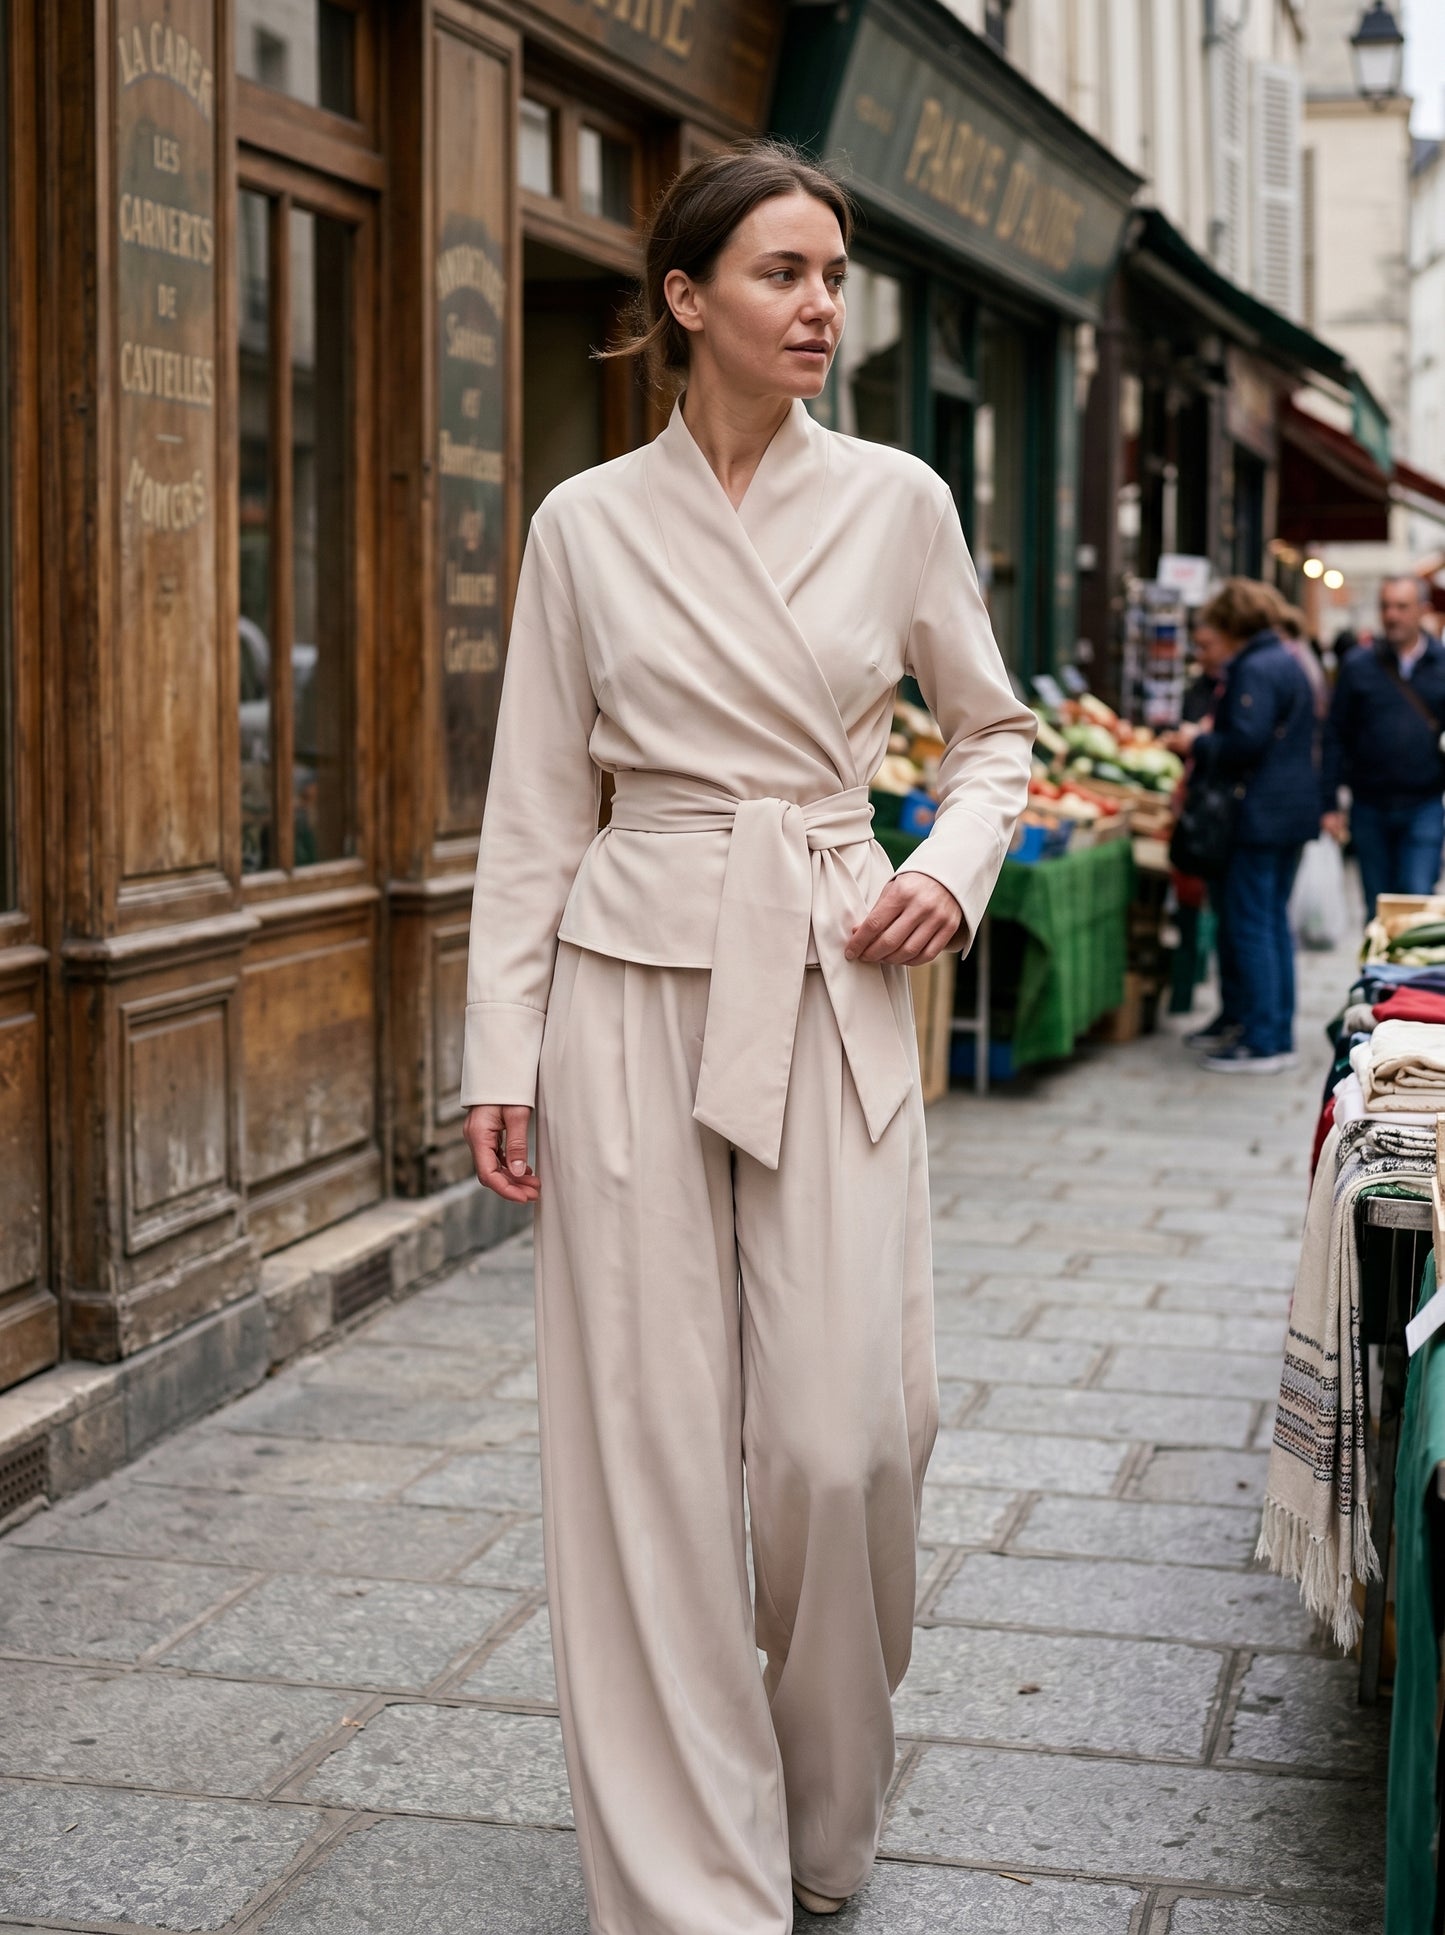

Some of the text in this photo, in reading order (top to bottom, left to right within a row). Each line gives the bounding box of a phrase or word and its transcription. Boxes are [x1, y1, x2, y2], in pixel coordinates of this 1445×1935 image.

[118, 26, 148, 85] LA
[153, 134, 181, 174] LES
[158, 283, 178, 320] DE
[121, 341, 214, 406] CASTELLES
